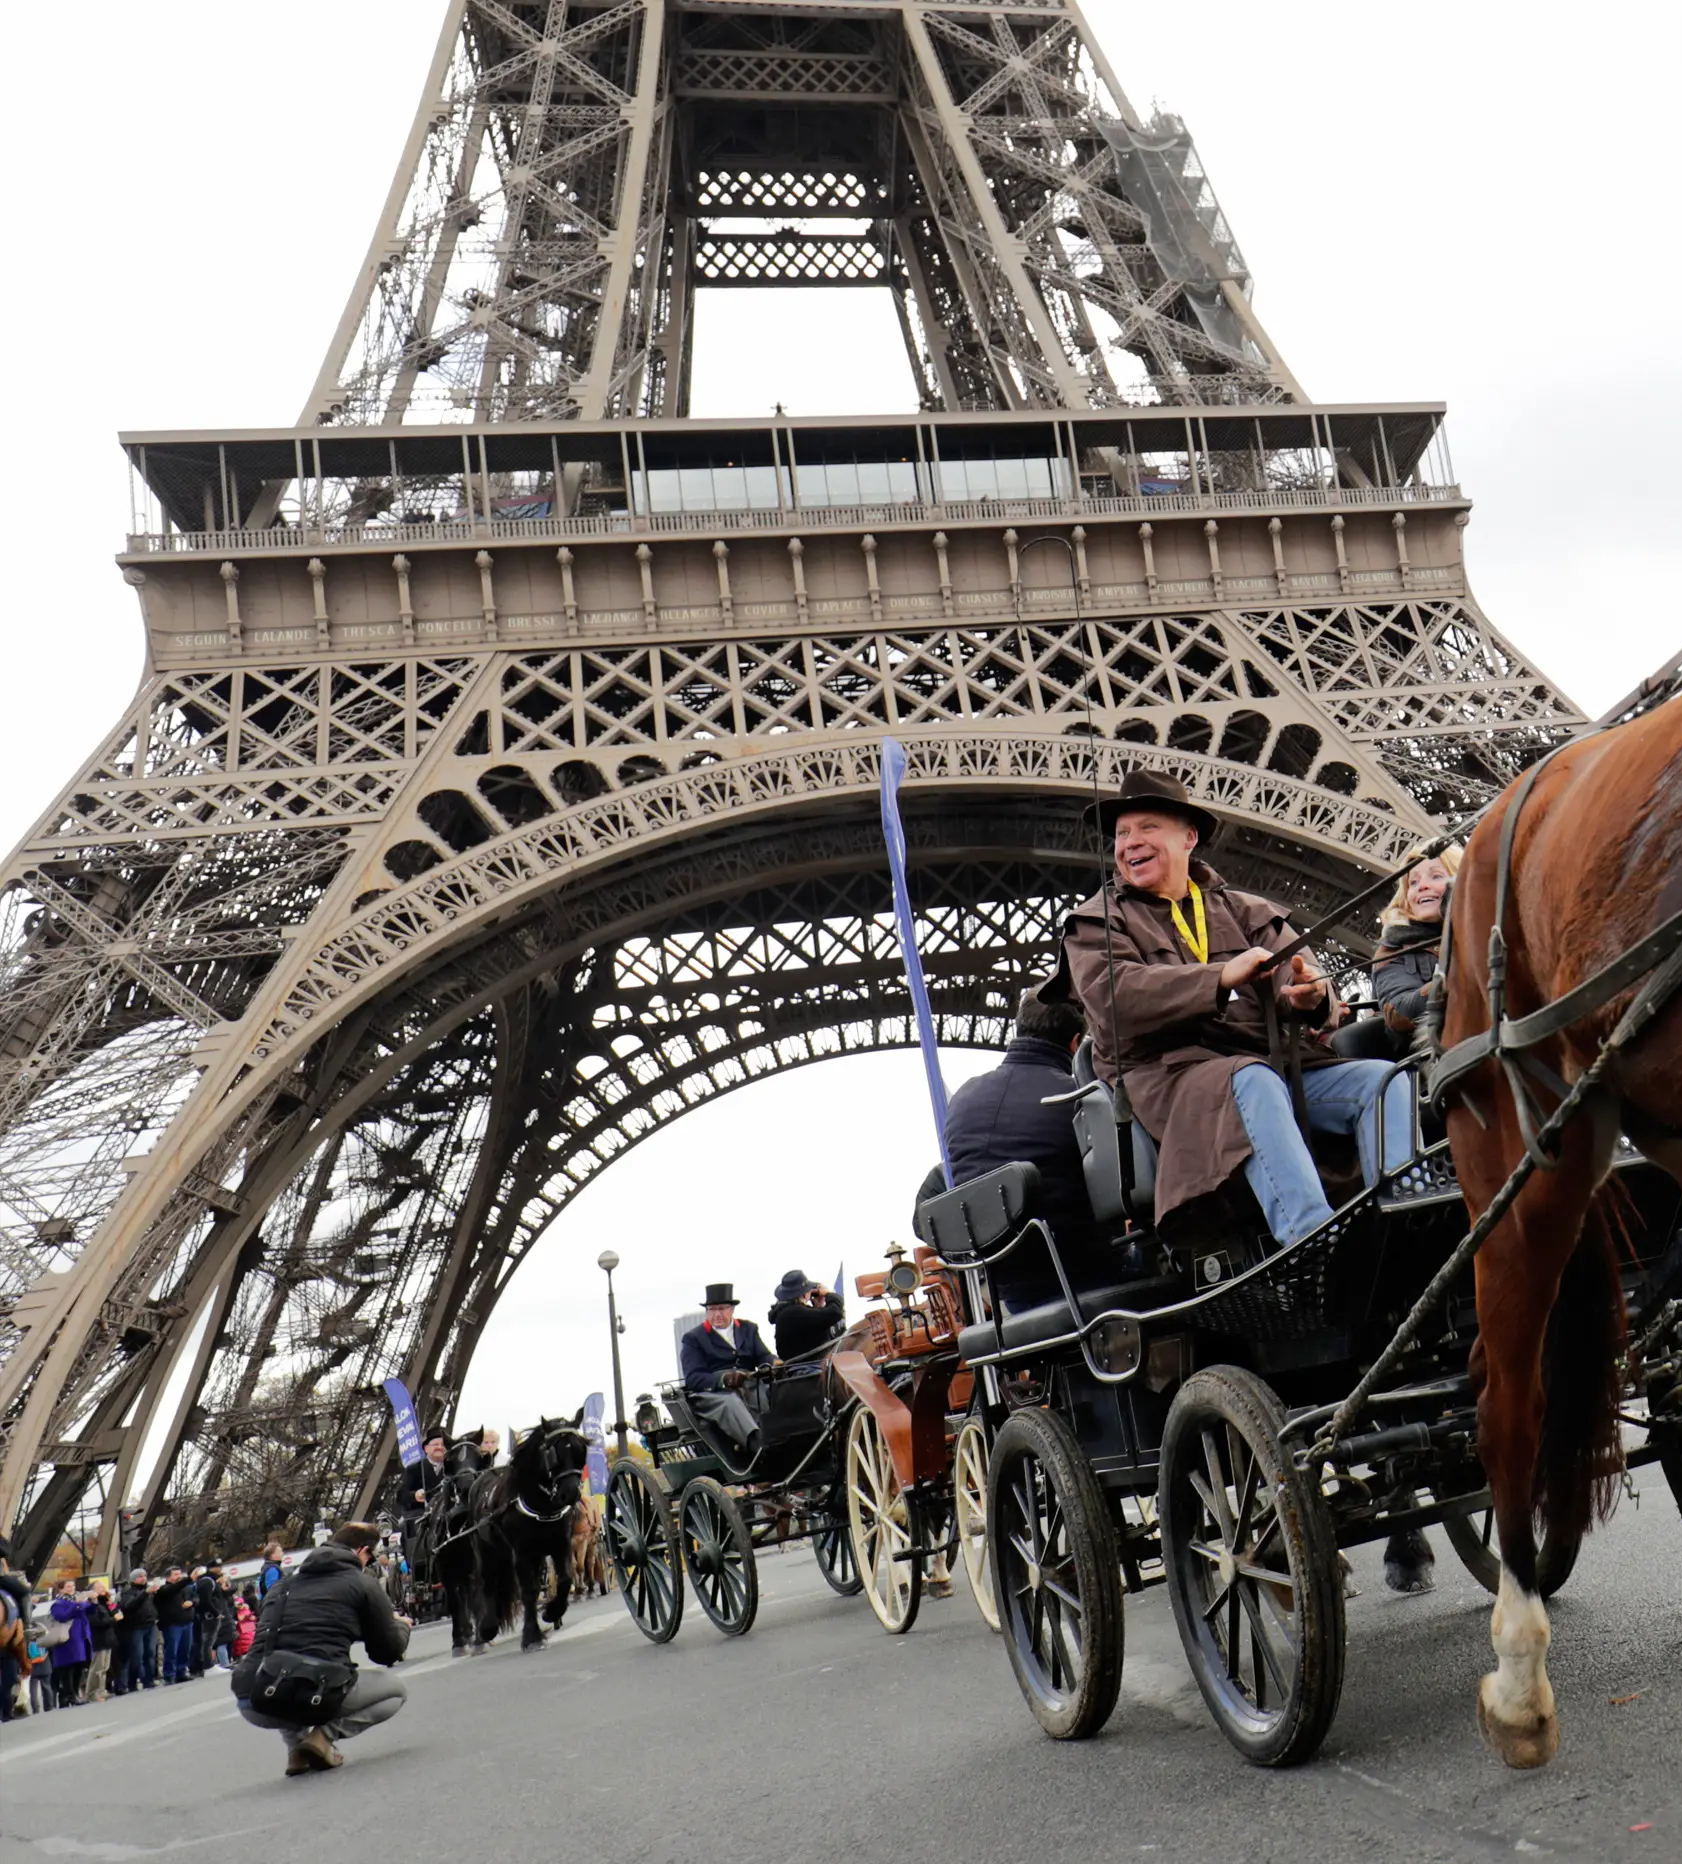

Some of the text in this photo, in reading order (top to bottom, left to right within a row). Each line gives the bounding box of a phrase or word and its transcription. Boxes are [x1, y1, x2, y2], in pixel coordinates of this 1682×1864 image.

[1291, 575, 1328, 587] NAVIER
[1351, 572, 1396, 584] LEGENDRE
[1097, 585, 1139, 598] AMPERE
[1156, 581, 1209, 593] CHEVREUL
[958, 592, 1007, 605] CHASLES
[1026, 588, 1076, 601] LAVOISIER
[744, 604, 788, 617] CUVIER
[816, 599, 863, 613] LAPLACE
[583, 611, 640, 625] LAGRANGE
[660, 607, 720, 621] BELANGER
[417, 620, 481, 633] PONCELET
[507, 615, 557, 629] BRESSE
[254, 629, 312, 644] LALANDE
[343, 624, 396, 638] TRESCA
[175, 632, 227, 648] SEGUIN
